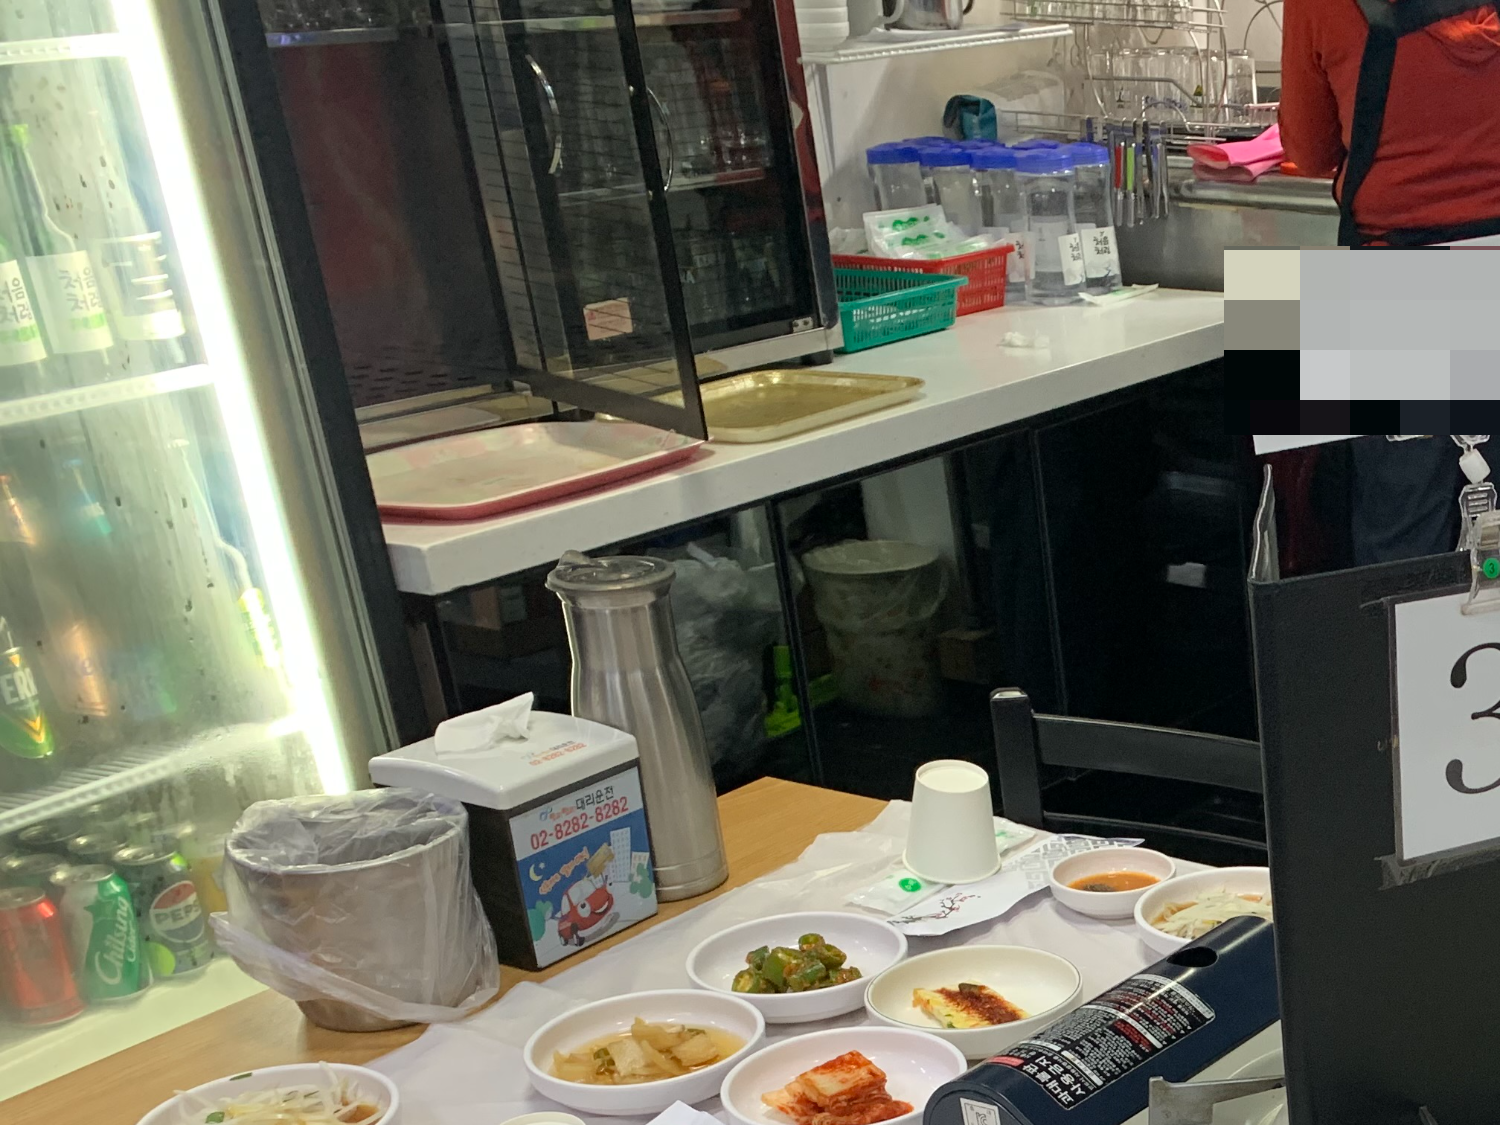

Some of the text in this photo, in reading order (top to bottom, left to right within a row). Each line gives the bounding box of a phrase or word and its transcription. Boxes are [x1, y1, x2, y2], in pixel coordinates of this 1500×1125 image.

[1489, 562, 1495, 575] 3
[575, 785, 614, 811] 대리운전
[530, 796, 629, 850] 02-8282-8282
[154, 899, 201, 925] PEPS
[94, 896, 134, 985] Chilsung
[1035, 1054, 1085, 1095] 사용금지
